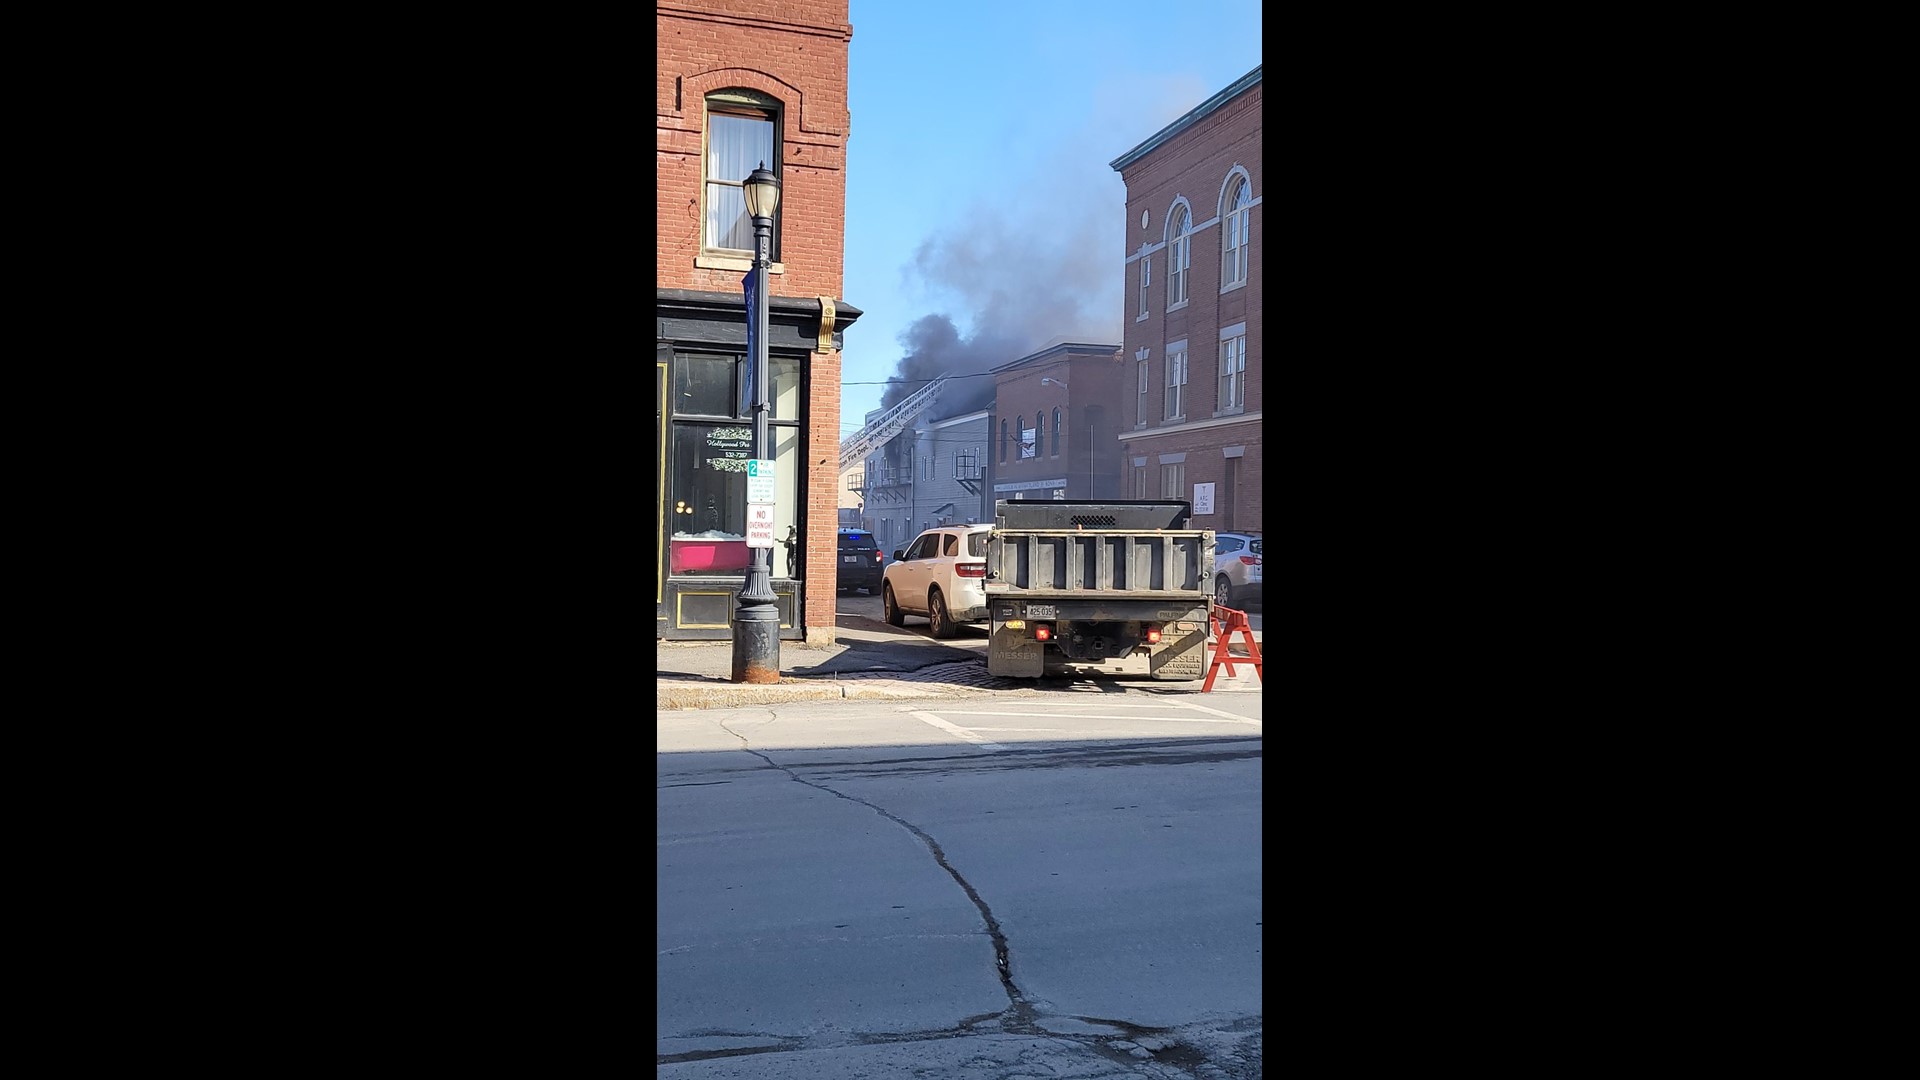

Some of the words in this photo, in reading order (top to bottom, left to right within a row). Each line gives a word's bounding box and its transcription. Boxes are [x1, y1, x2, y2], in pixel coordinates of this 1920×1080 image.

[706, 439, 739, 448] Hollywood
[847, 450, 858, 462] Fire
[750, 463, 757, 475] 2
[756, 510, 766, 519] NO
[749, 521, 773, 530] OVERNIGHT
[750, 531, 771, 540] PARKING
[995, 651, 1038, 660] MESSER
[1158, 653, 1200, 663] MESSER
